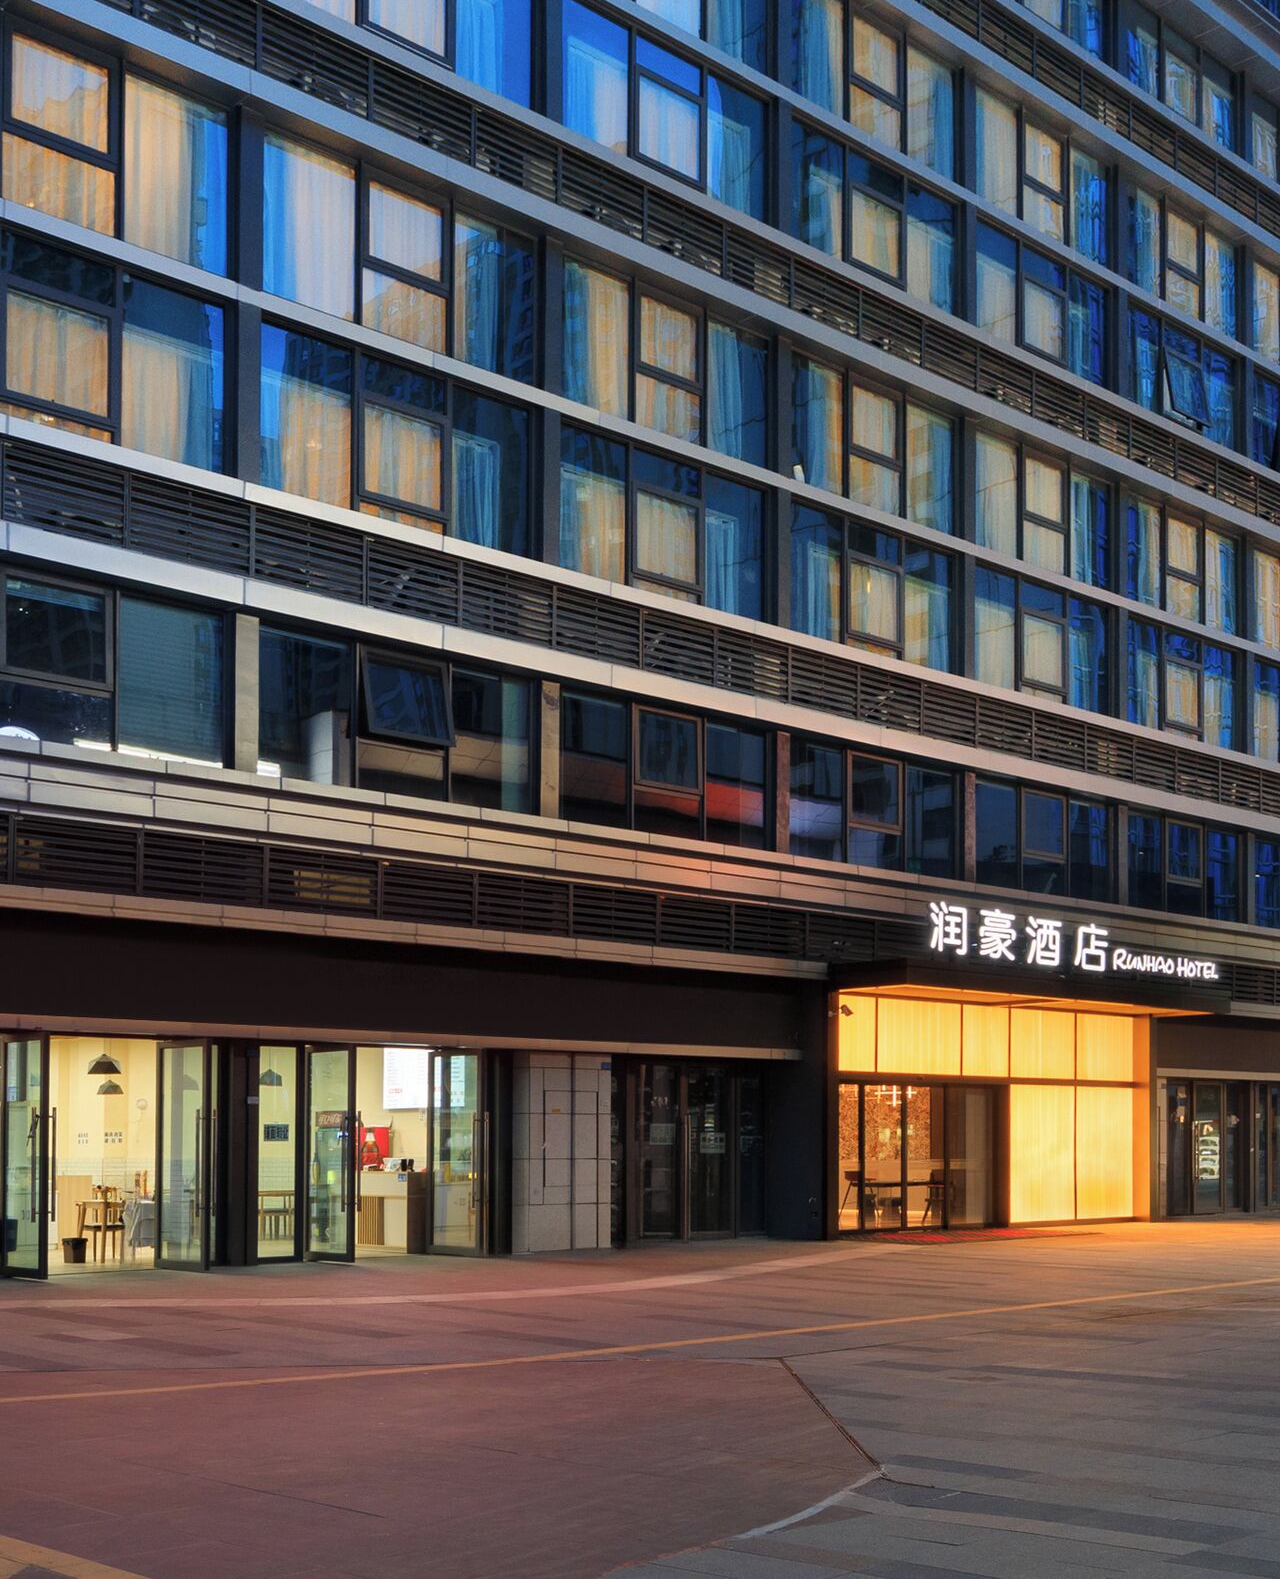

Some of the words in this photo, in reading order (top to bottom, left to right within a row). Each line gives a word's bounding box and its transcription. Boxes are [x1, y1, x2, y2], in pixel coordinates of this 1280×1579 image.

[930, 902, 1109, 972] 润豪酒店
[1114, 950, 1174, 974] RUNHAO
[1177, 959, 1219, 979] HOTEL
